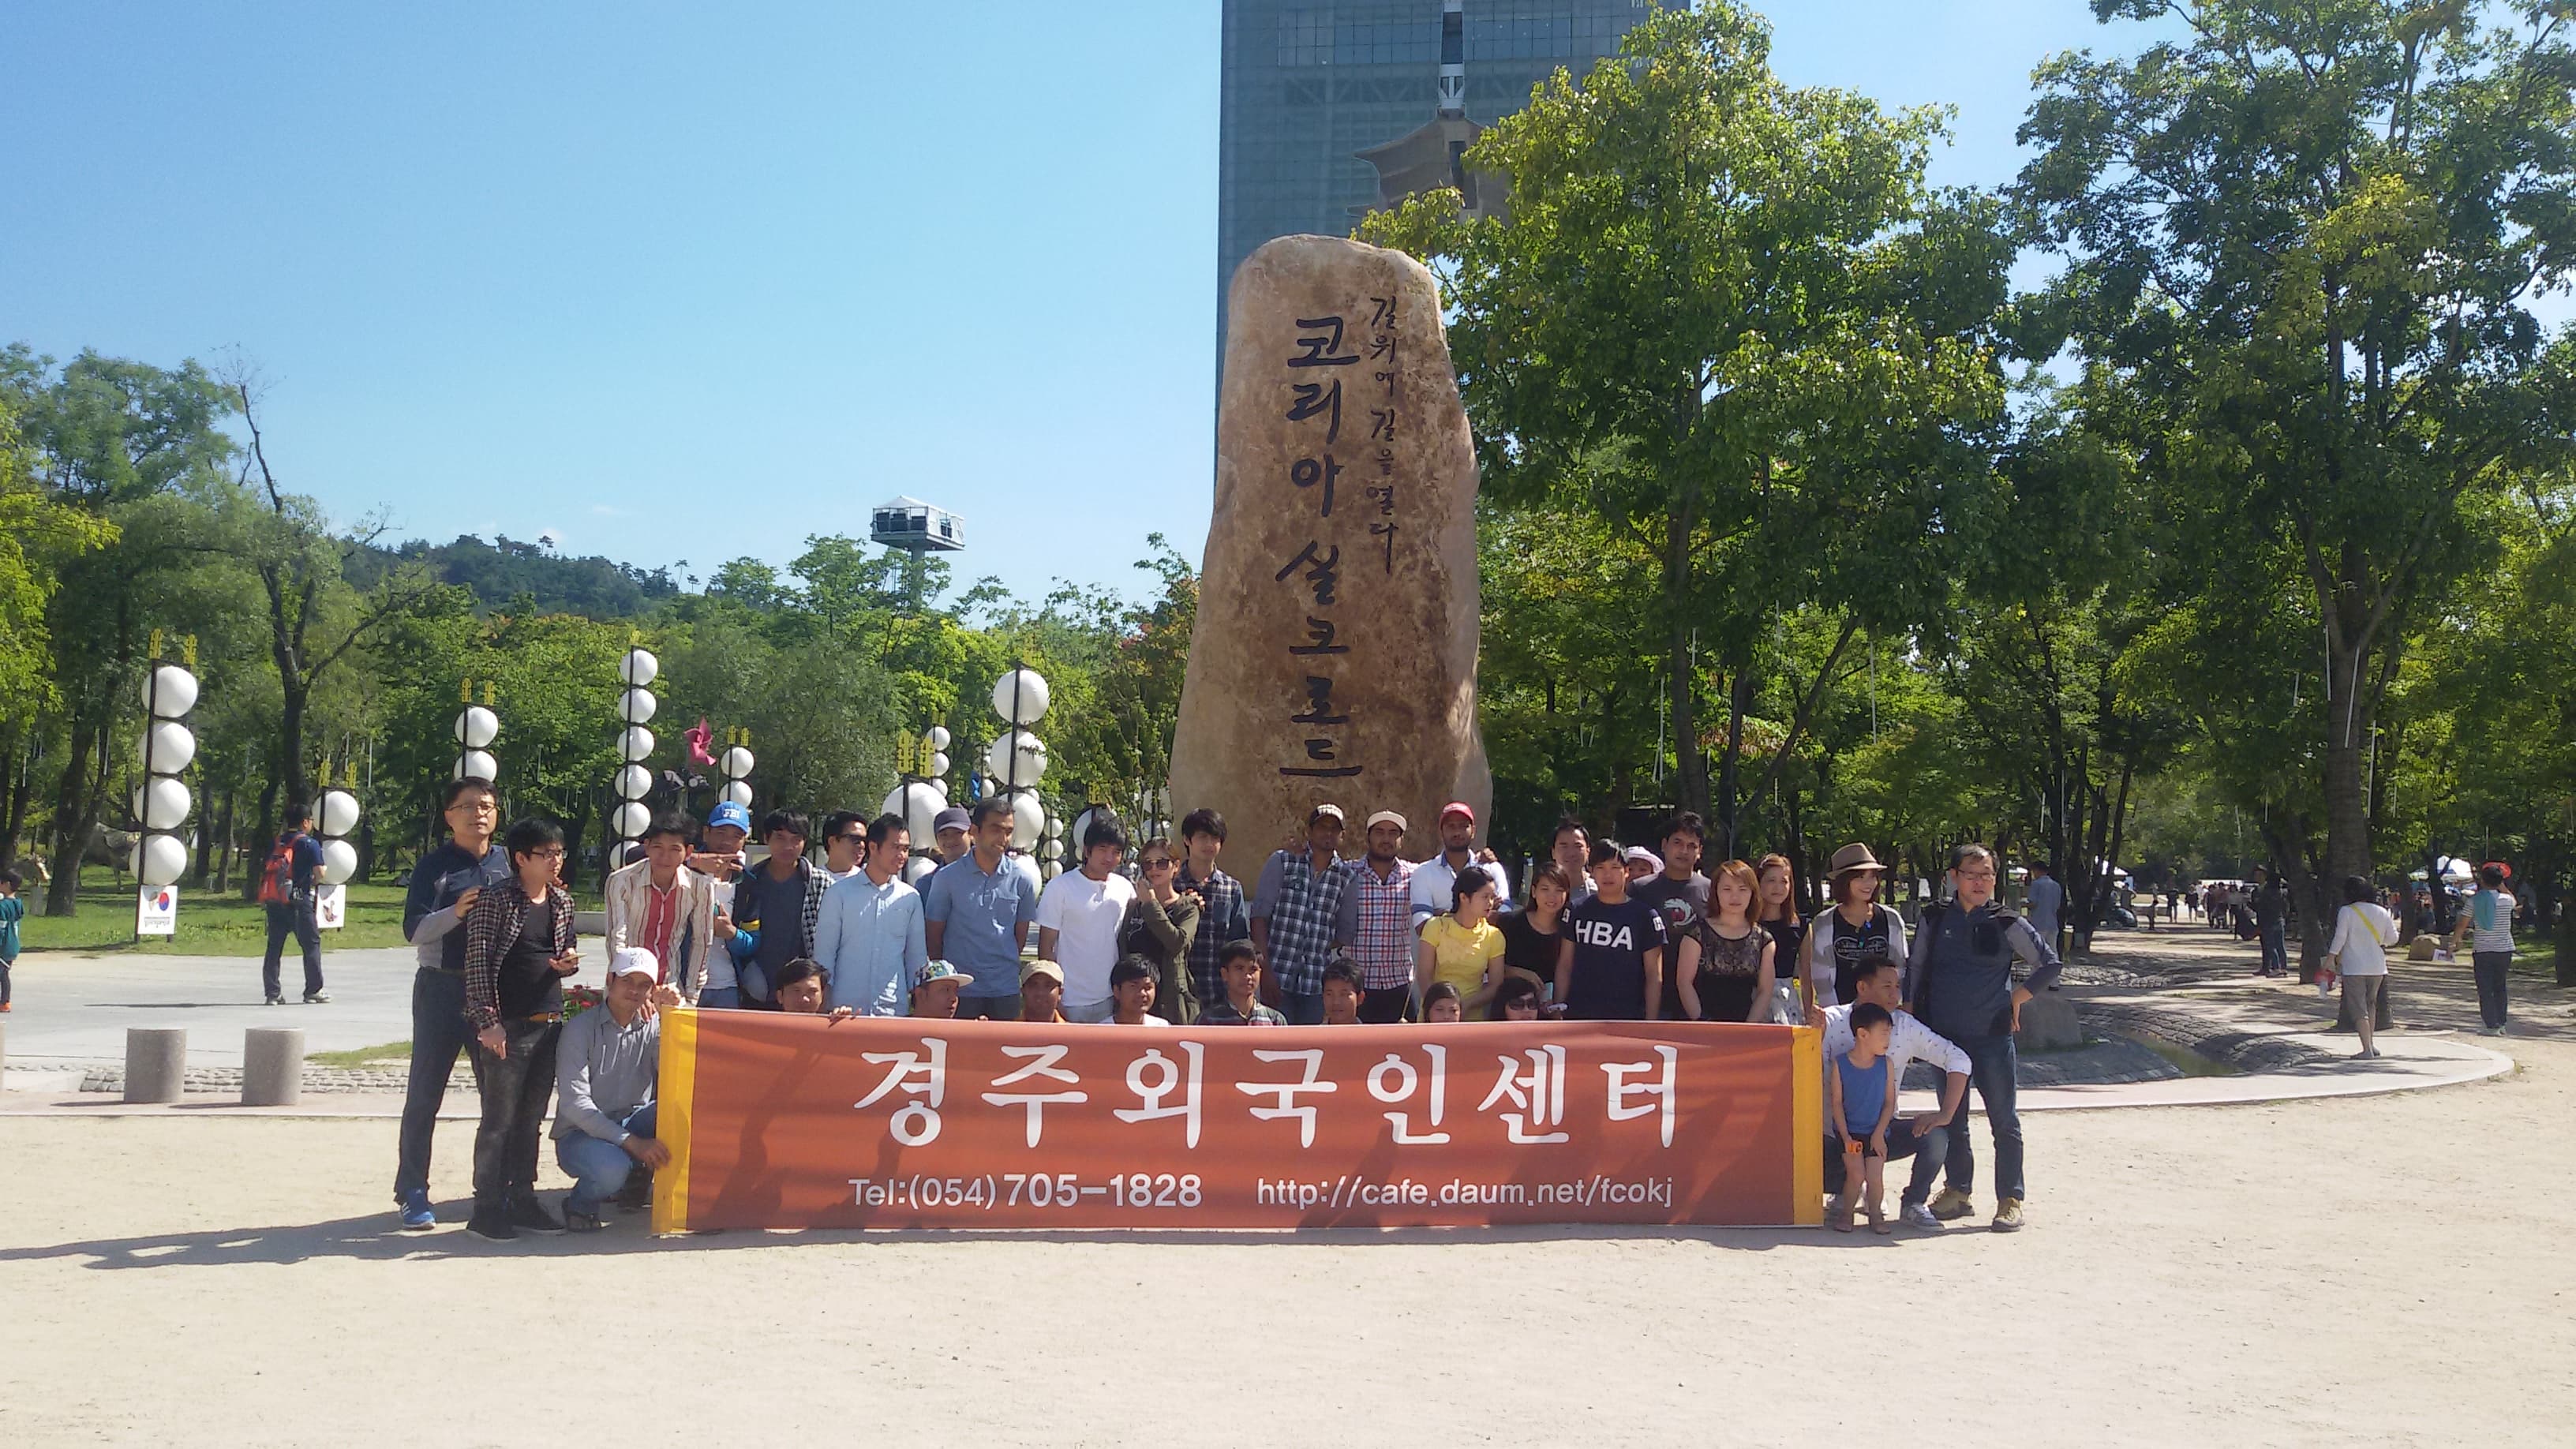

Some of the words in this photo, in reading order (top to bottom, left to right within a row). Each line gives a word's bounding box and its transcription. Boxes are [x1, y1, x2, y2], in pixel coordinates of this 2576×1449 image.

[1286, 316, 1360, 518] 코리아
[1575, 919, 1633, 951] HBA
[853, 1036, 1678, 1150] 경주외국인센터
[1257, 1174, 1673, 1209] http://cafe.daum.net/fcokj
